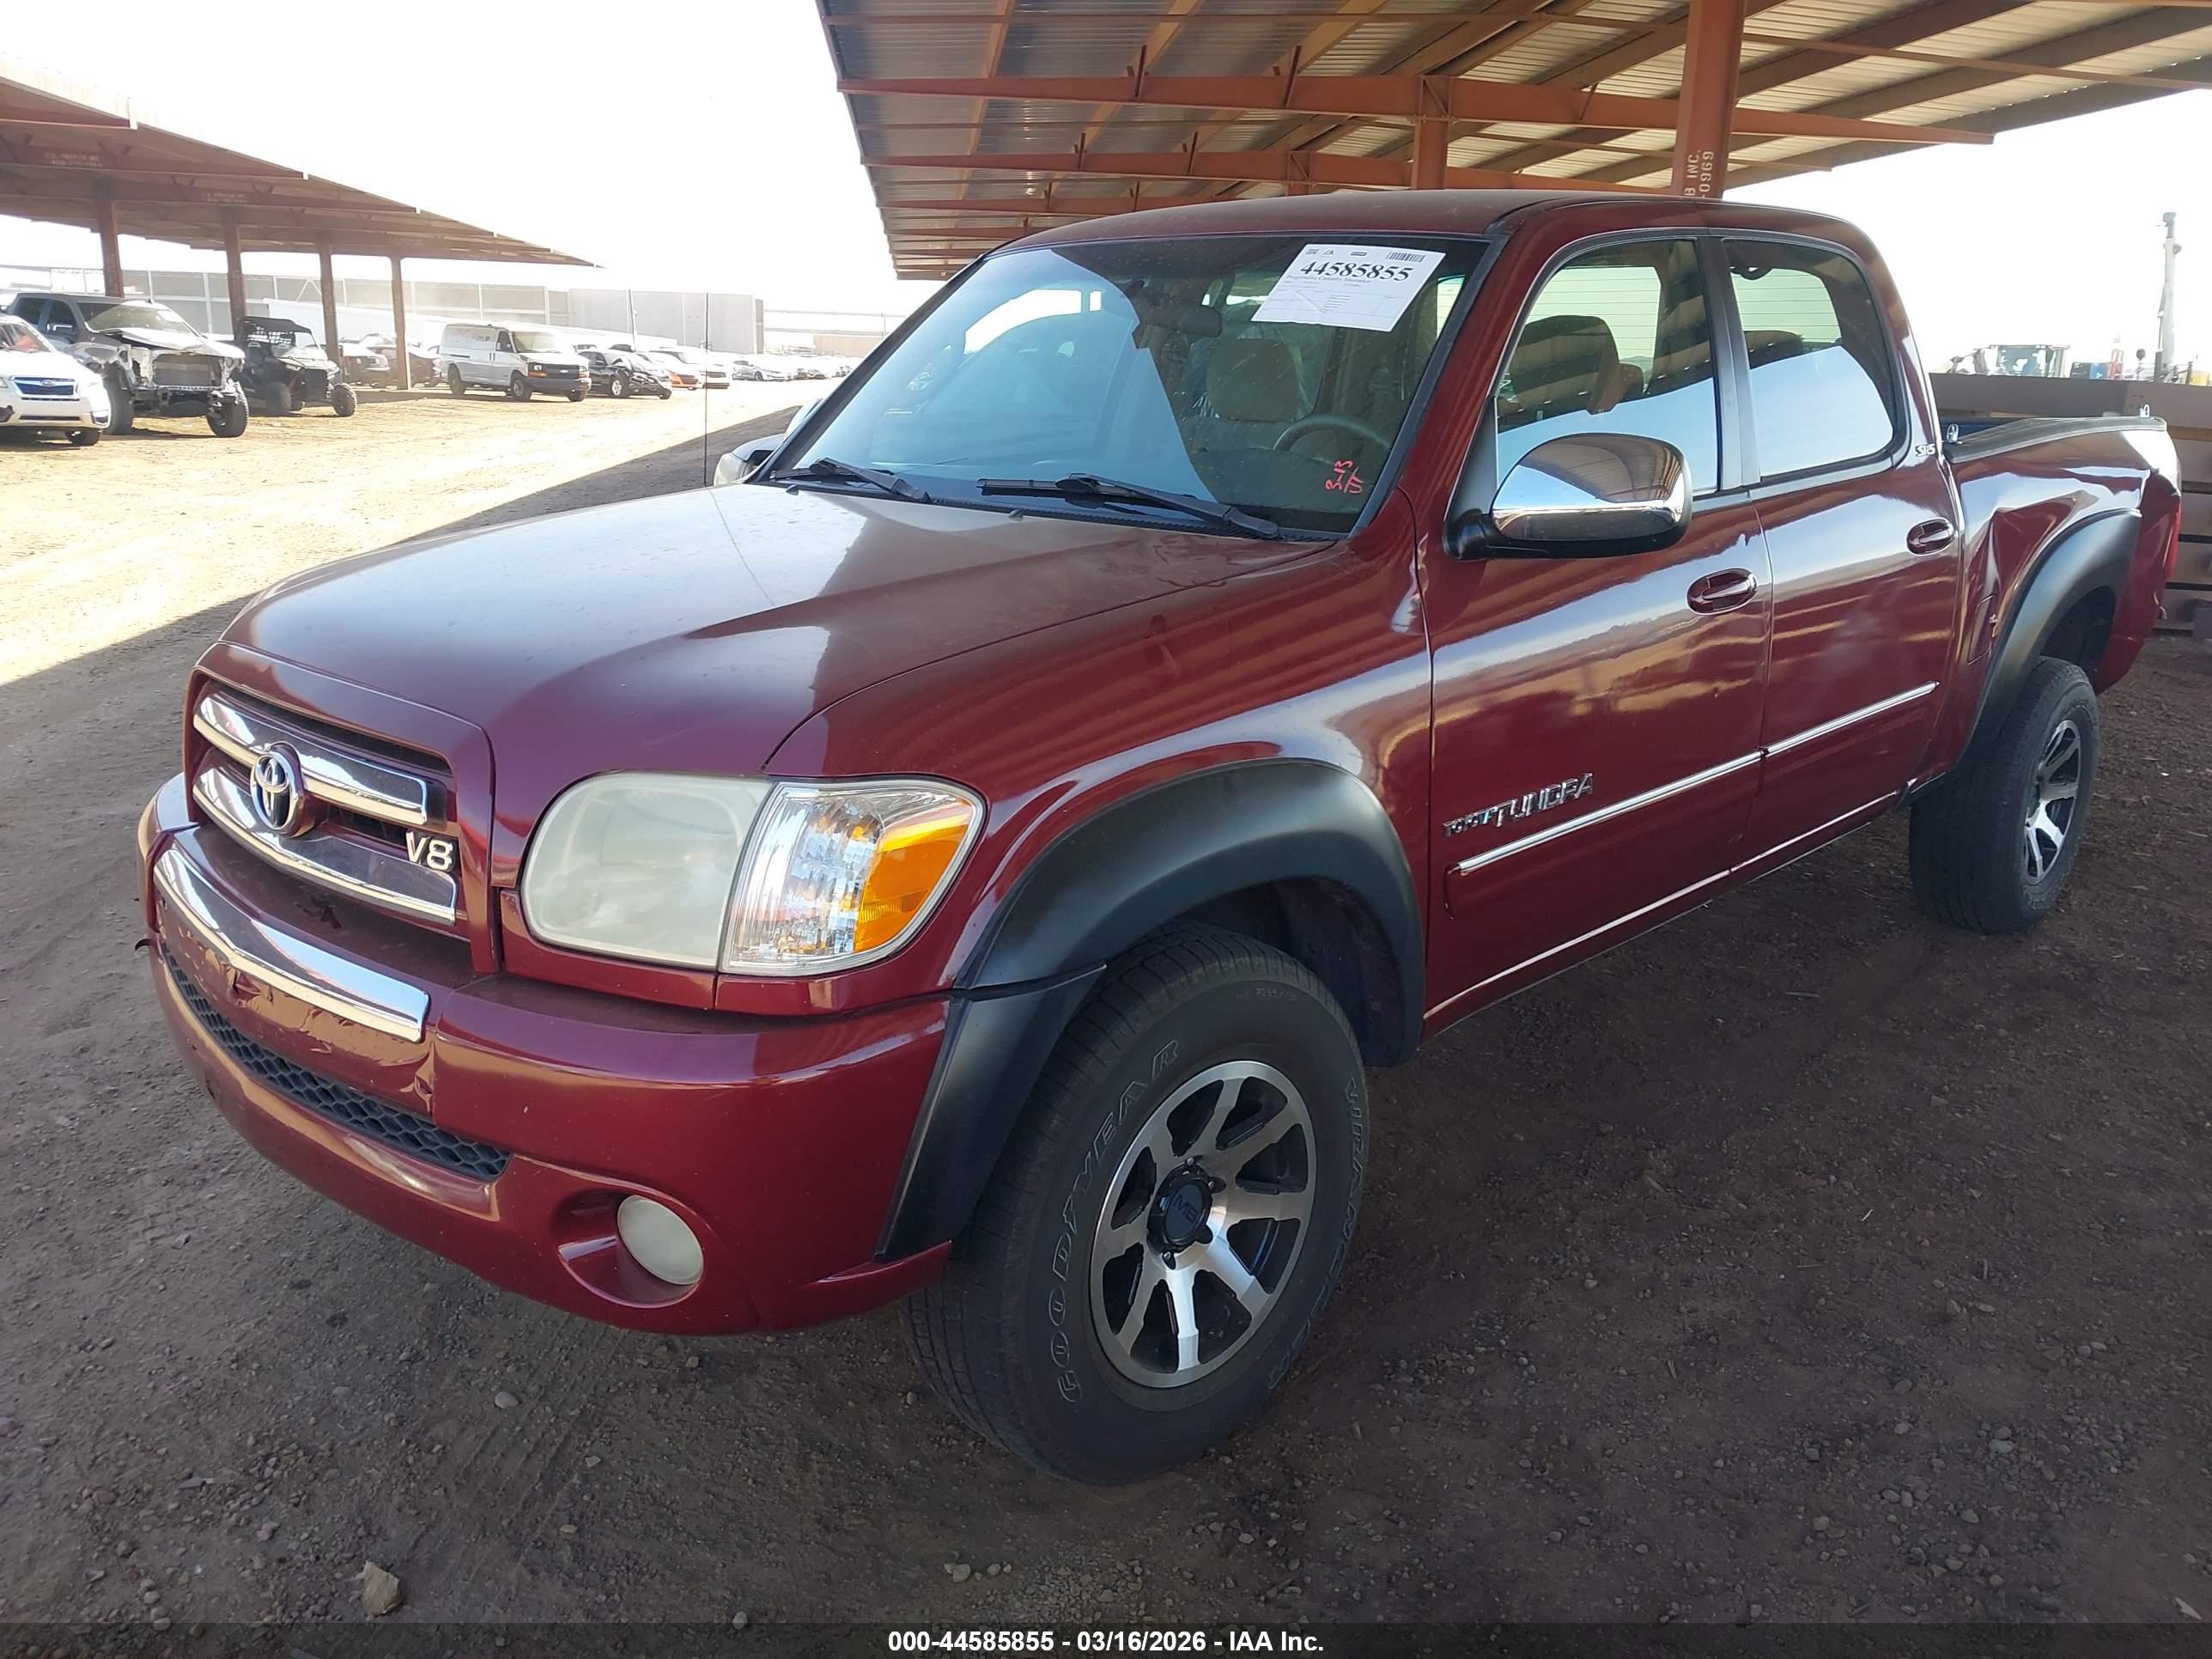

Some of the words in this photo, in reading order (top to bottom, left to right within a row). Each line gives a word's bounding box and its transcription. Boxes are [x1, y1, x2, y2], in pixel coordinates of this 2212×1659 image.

[1686, 149, 1701, 179] INC.
[1300, 260, 1414, 282] 44585855
[1914, 443, 1937, 457] SR5
[1491, 773, 1595, 828] TUNDRA
[405, 830, 453, 871] V8
[1048, 1038, 1180, 1403] GOODYEAR
